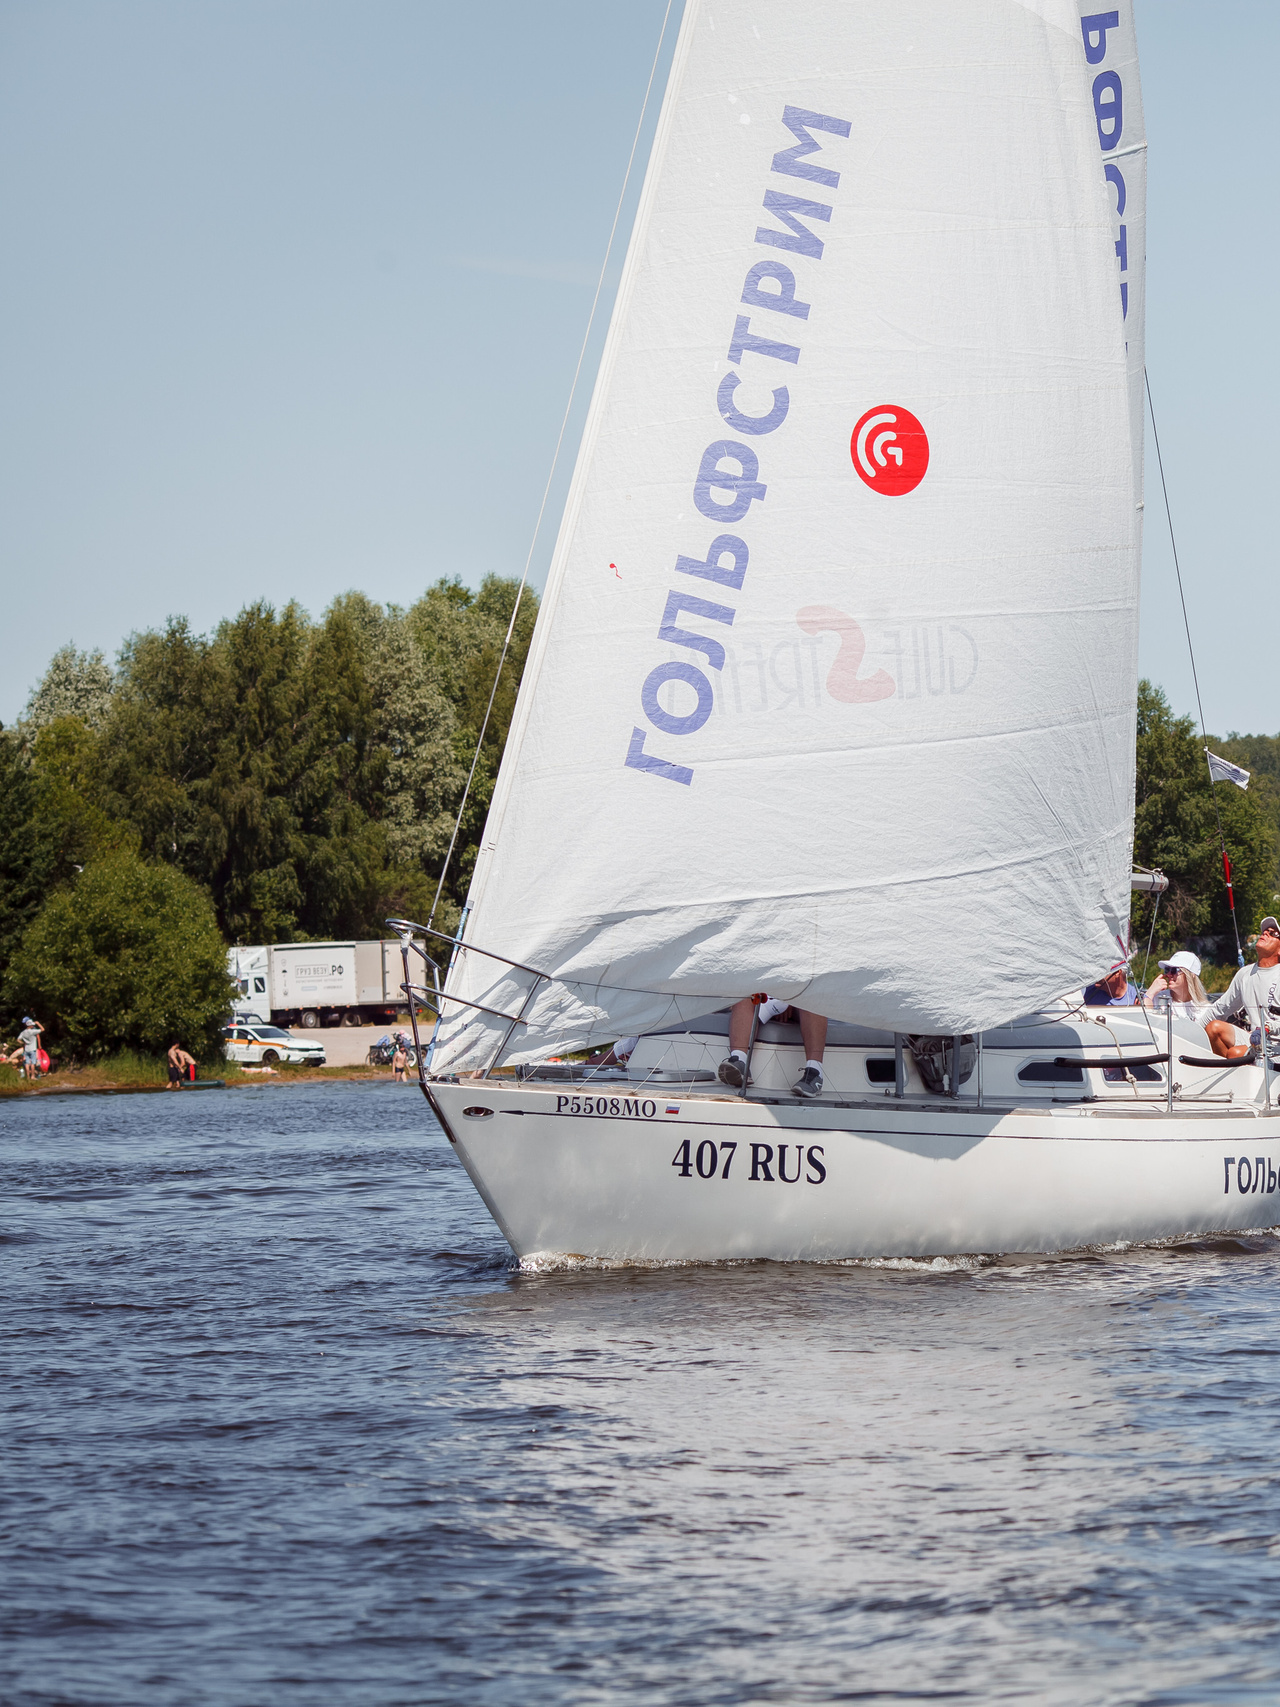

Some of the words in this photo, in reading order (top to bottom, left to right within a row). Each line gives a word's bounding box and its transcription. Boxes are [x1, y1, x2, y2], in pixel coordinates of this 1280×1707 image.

[624, 104, 853, 786] ГОЛЬФСТРИМ
[671, 1139, 738, 1179] 407
[748, 1142, 827, 1185] RUS
